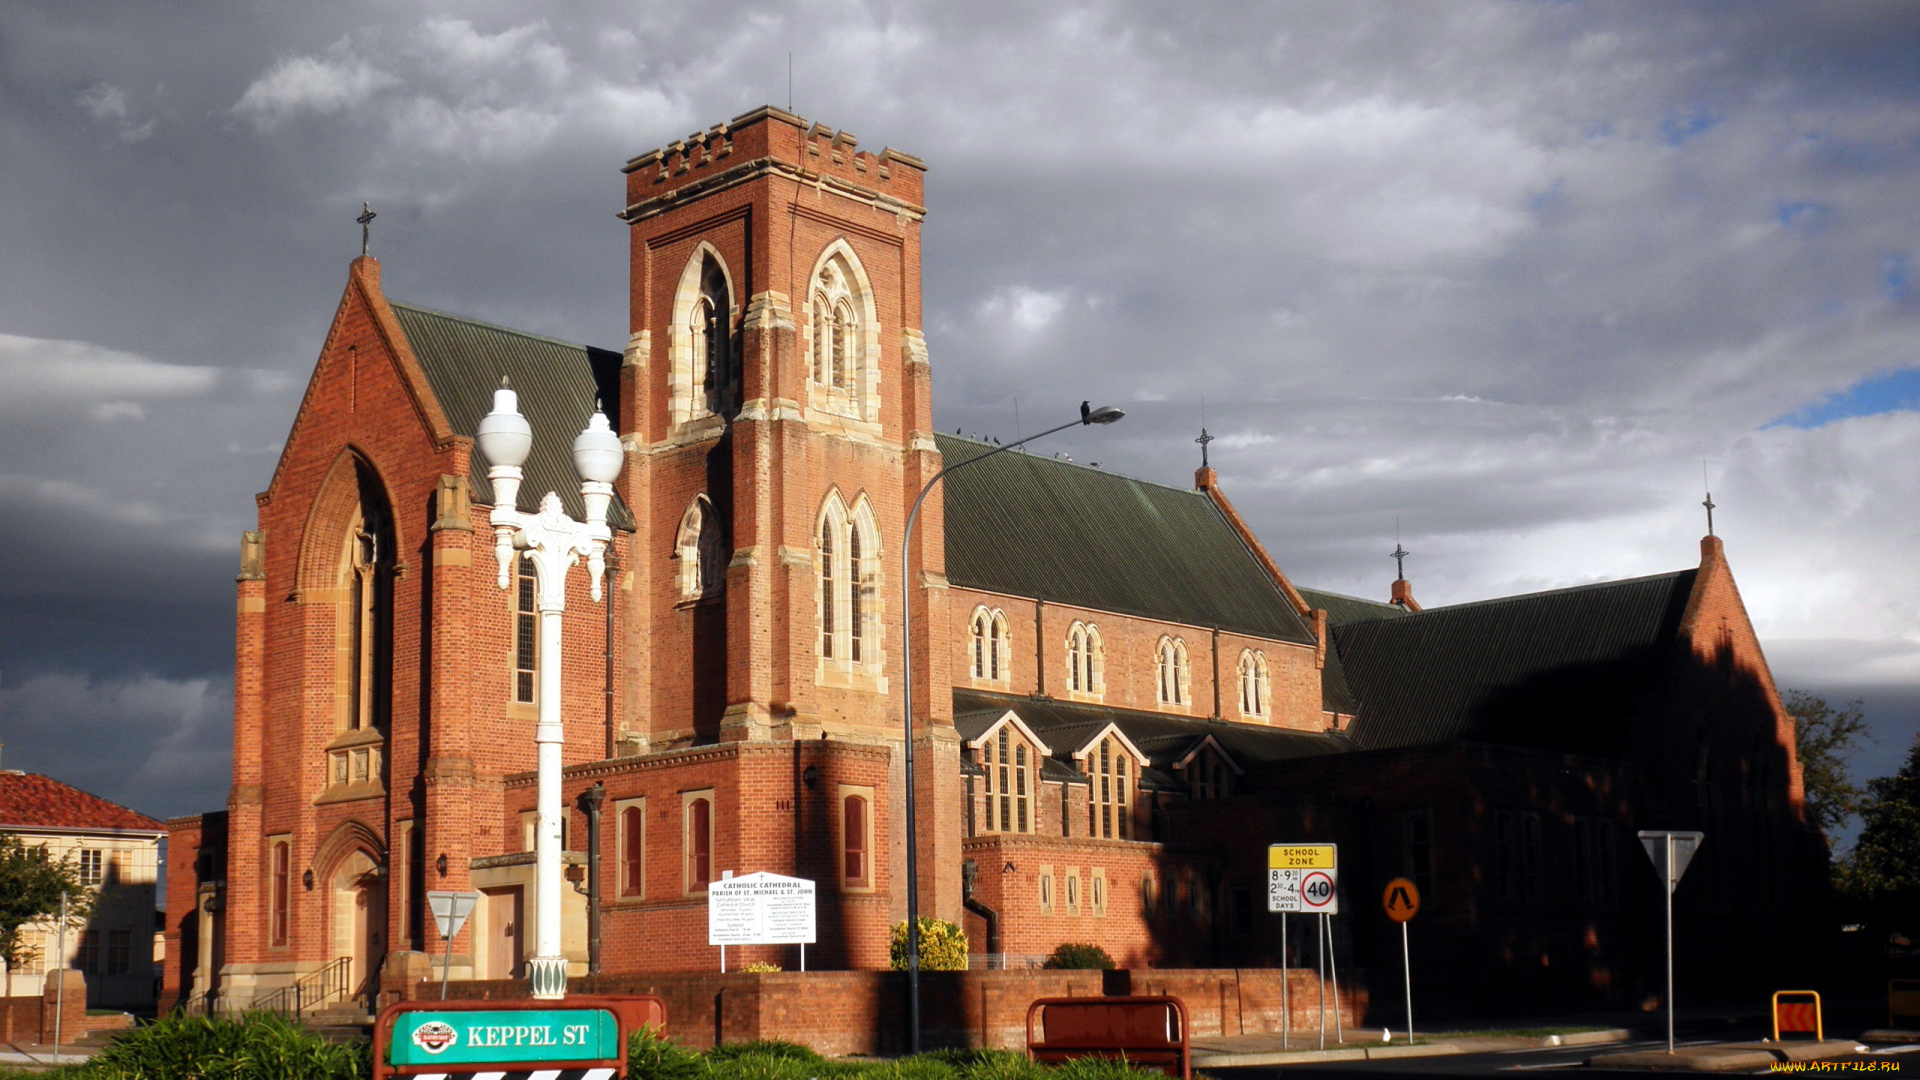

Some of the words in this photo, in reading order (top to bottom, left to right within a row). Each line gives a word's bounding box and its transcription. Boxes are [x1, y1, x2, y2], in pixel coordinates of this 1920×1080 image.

[1283, 848, 1320, 856] SCHOOL
[1307, 881, 1329, 897] 40
[466, 1026, 557, 1047] KEPPEL
[563, 1025, 589, 1045] ST
